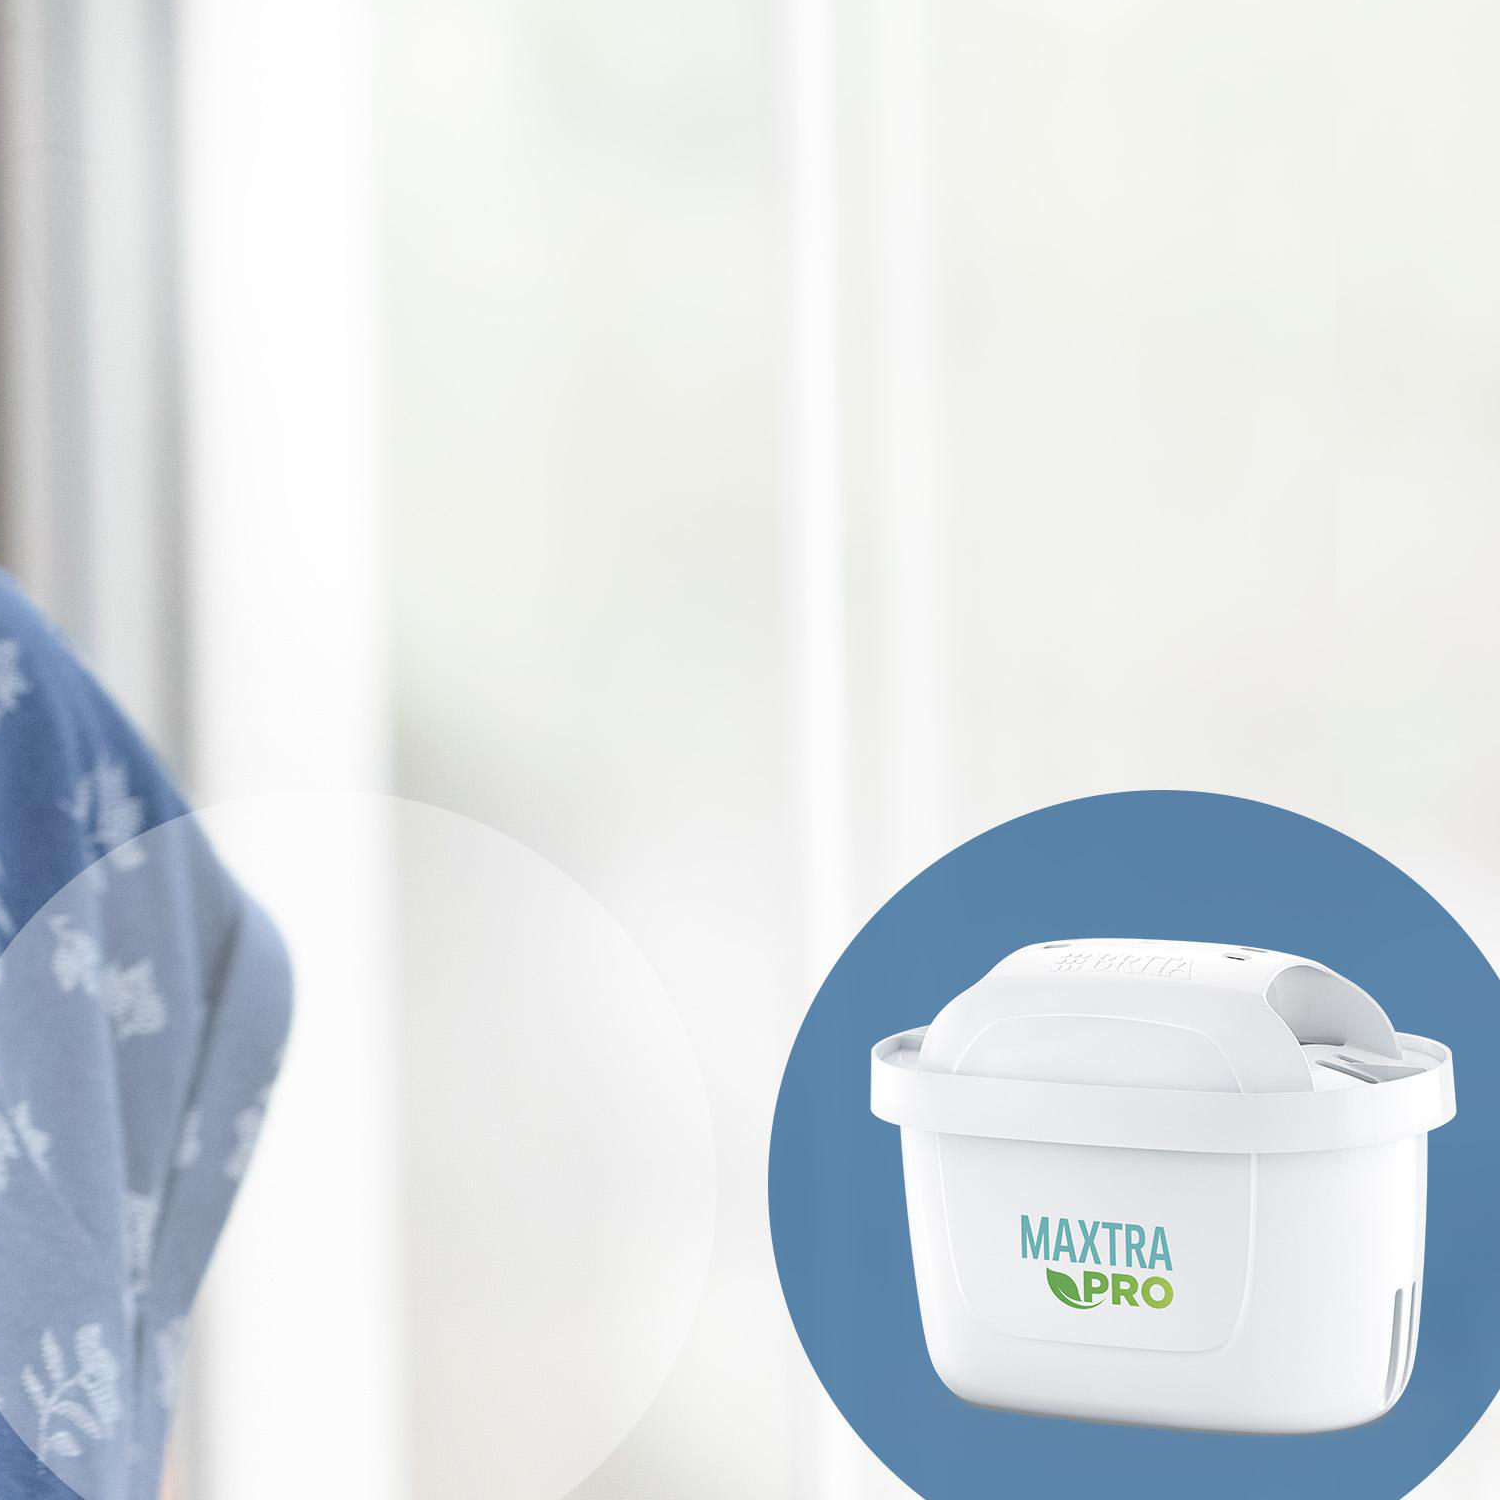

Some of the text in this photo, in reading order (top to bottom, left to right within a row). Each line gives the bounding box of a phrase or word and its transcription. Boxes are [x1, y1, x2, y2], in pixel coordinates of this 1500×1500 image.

[1092, 952, 1194, 982] BRITA
[1020, 1214, 1173, 1272] MAXTRA
[1083, 1270, 1174, 1310] PRO
